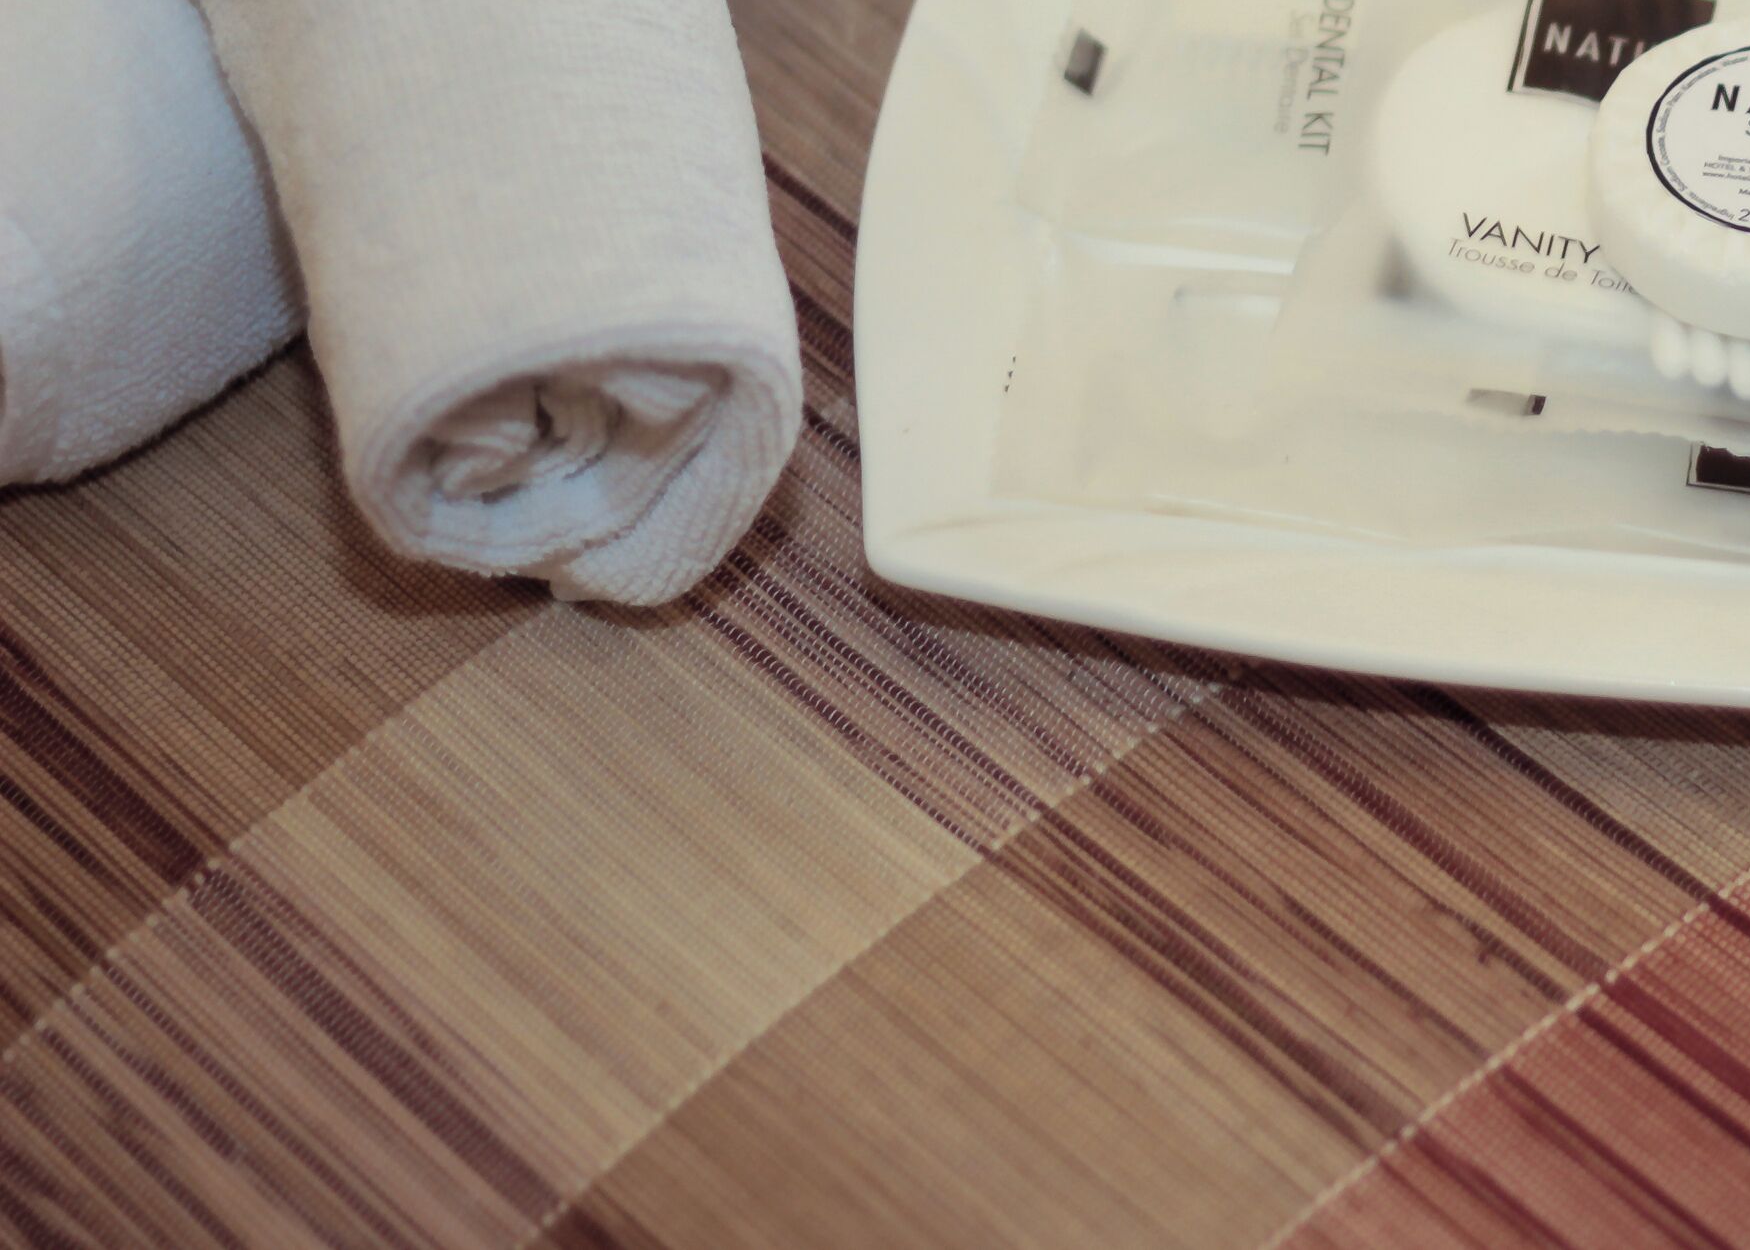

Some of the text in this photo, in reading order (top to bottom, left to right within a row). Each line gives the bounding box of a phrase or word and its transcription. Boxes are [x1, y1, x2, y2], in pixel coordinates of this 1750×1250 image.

[1544, 22, 1646, 67] NAT
[1298, 112, 1334, 157] KIT
[1448, 238, 1535, 274] Trousse
[1544, 262, 1578, 281] de
[1463, 212, 1600, 264] VANITY
